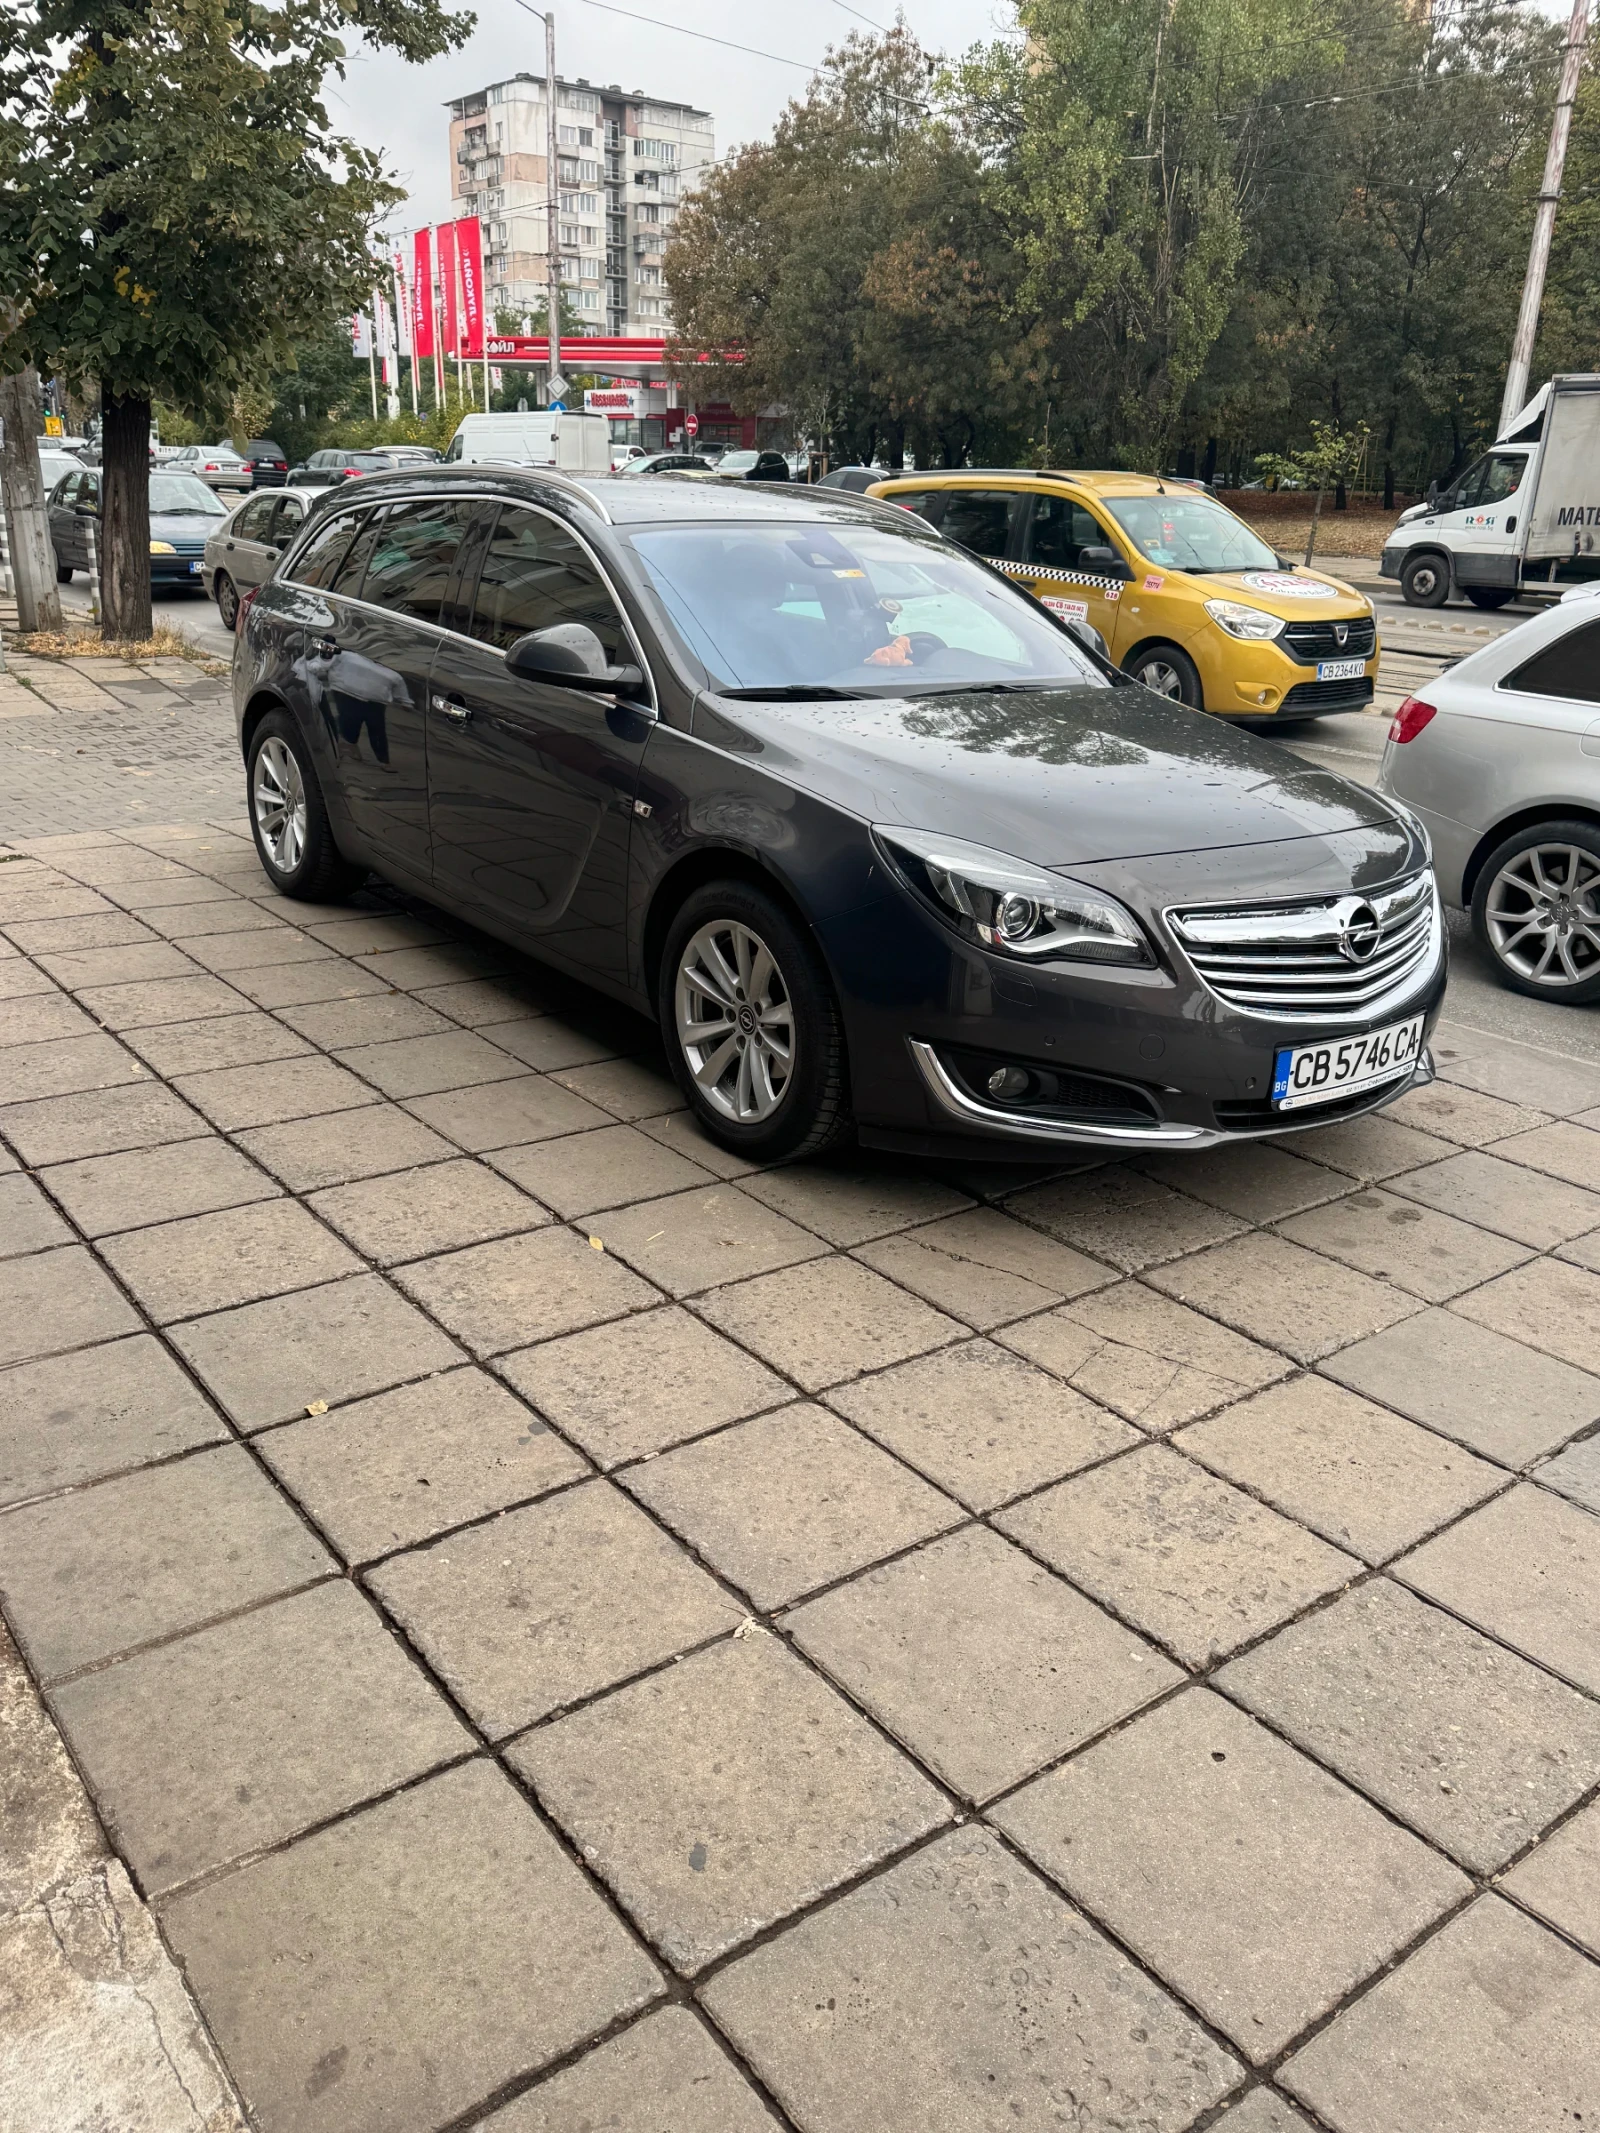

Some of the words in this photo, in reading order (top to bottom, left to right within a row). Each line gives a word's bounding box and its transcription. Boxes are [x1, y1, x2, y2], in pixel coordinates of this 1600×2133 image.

[590, 392, 630, 408] HESBURGER
[1105, 591, 1118, 600] 628
[1323, 665, 1334, 679] CB
[1334, 663, 1354, 678] 2364
[1293, 1050, 1331, 1089] CB
[1334, 1033, 1391, 1080] 5746
[1394, 1023, 1417, 1062] CA
[1274, 1080, 1287, 1093] BG
